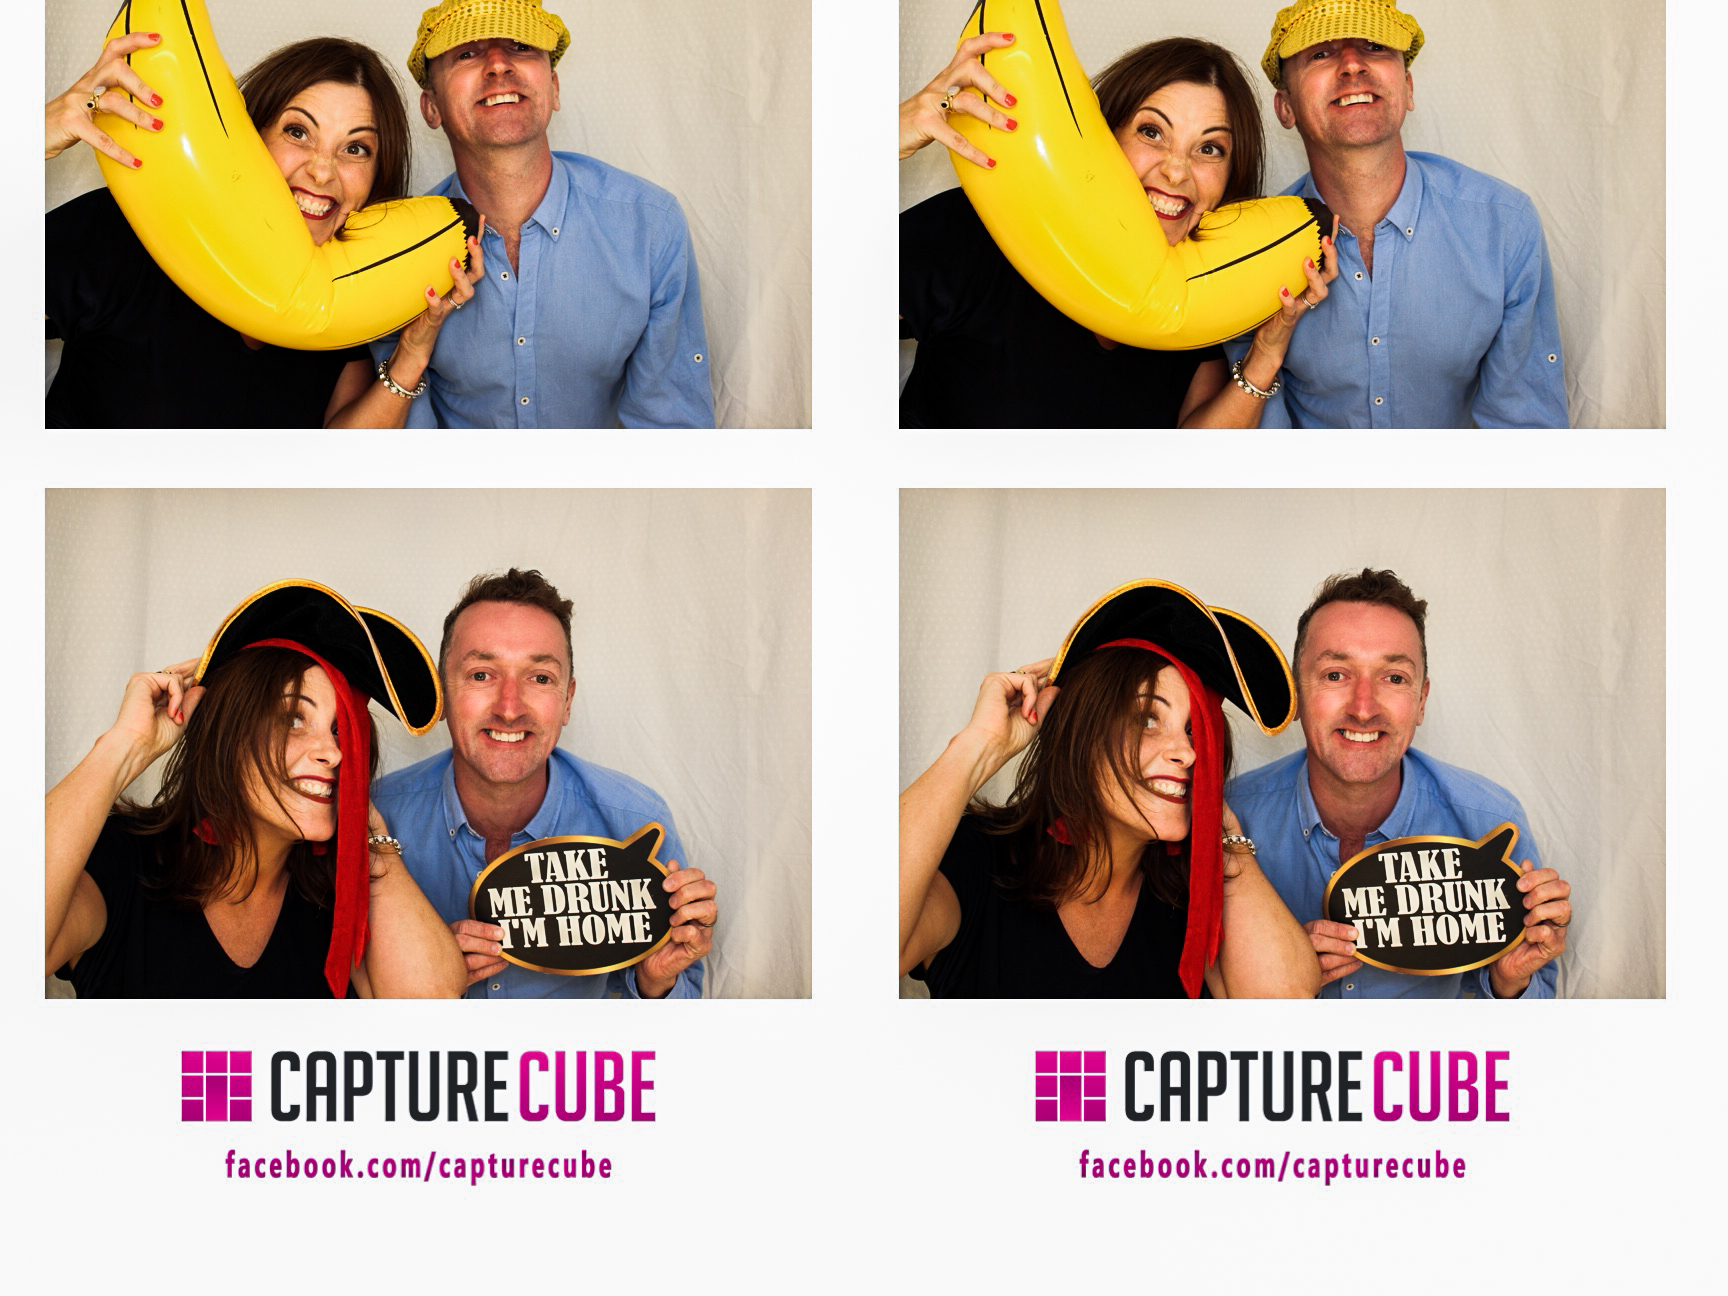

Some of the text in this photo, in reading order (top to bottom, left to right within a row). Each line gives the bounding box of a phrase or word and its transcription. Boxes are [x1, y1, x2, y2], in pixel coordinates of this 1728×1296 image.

[524, 847, 609, 884] TAKE
[1378, 847, 1463, 884] TAKE
[487, 878, 656, 918] ME DRUNK
[1341, 878, 1510, 918] ME DRUNK
[497, 912, 652, 949] I'M HOME
[1351, 912, 1506, 949] I'M HOME
